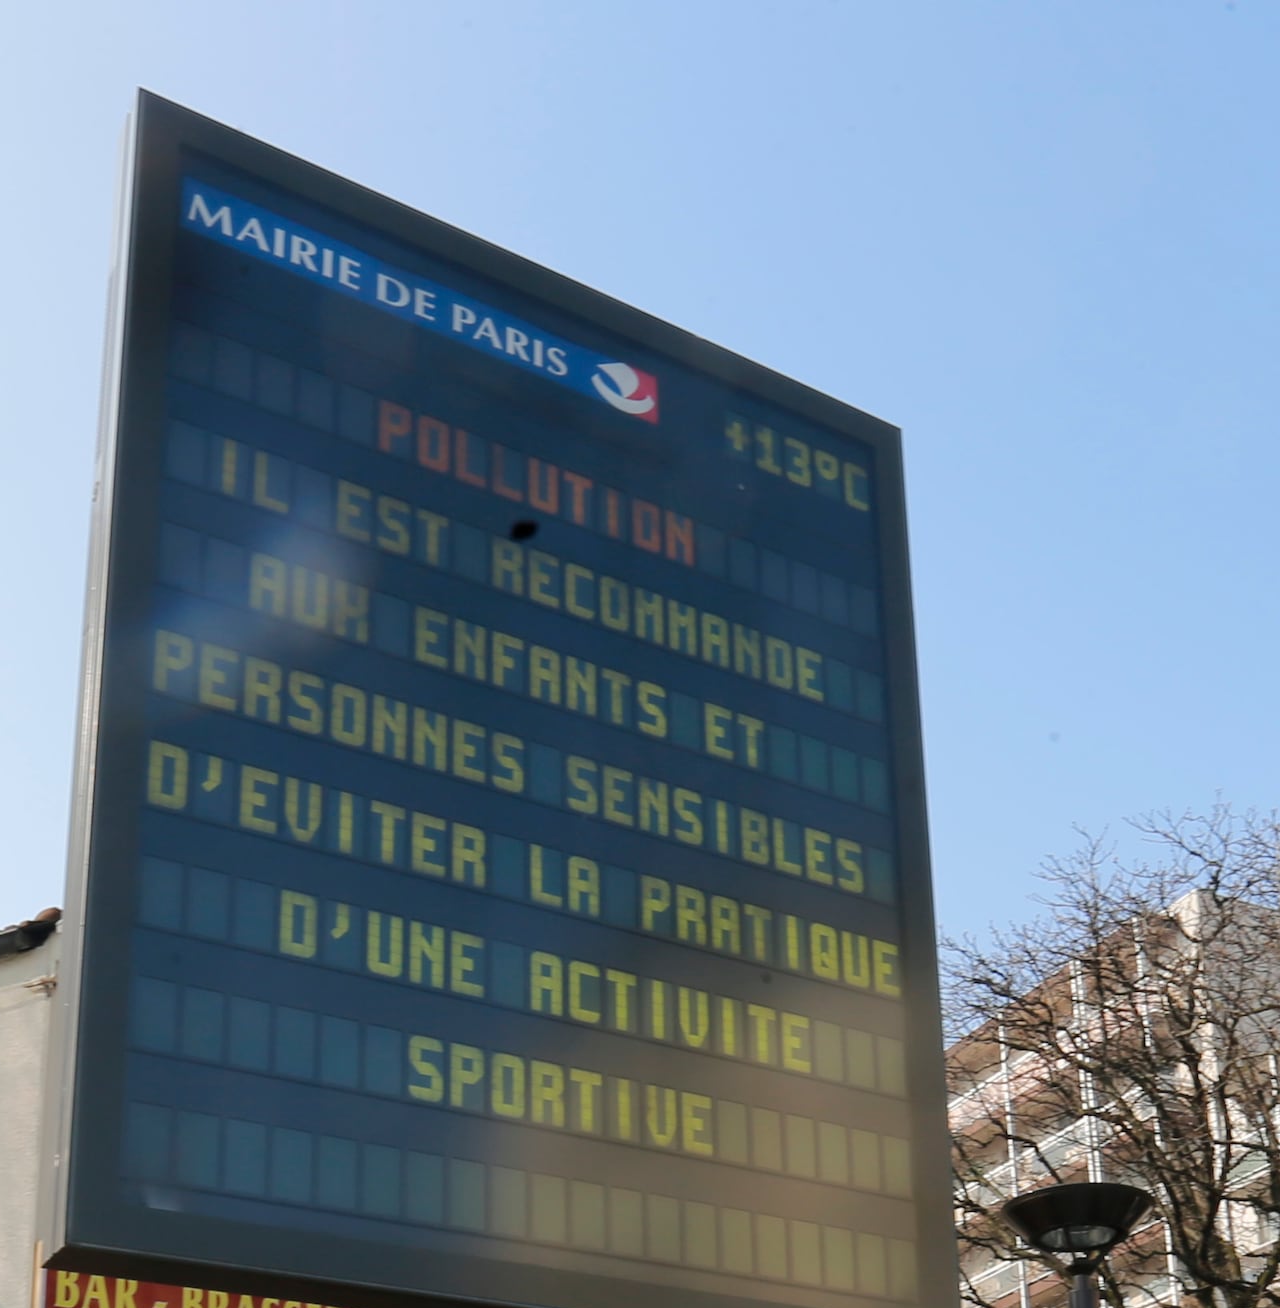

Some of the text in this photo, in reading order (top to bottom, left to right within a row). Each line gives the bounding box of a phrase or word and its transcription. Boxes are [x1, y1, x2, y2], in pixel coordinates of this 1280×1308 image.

[186, 193, 569, 378] MAIRIE DE PARIS
[220, 438, 826, 703] IL EST RECOMMANDE
[377, 401, 697, 567] POLLUTION
[248, 551, 766, 769] AUX ENFANTS ET
[153, 628, 865, 895] PERSONNES SENSIBLES
[147, 739, 902, 998] D'EVITER LA PRATIQUE
[278, 889, 814, 1075] D'UNE ACTIVITE
[407, 1034, 716, 1157] SPORTIVE
